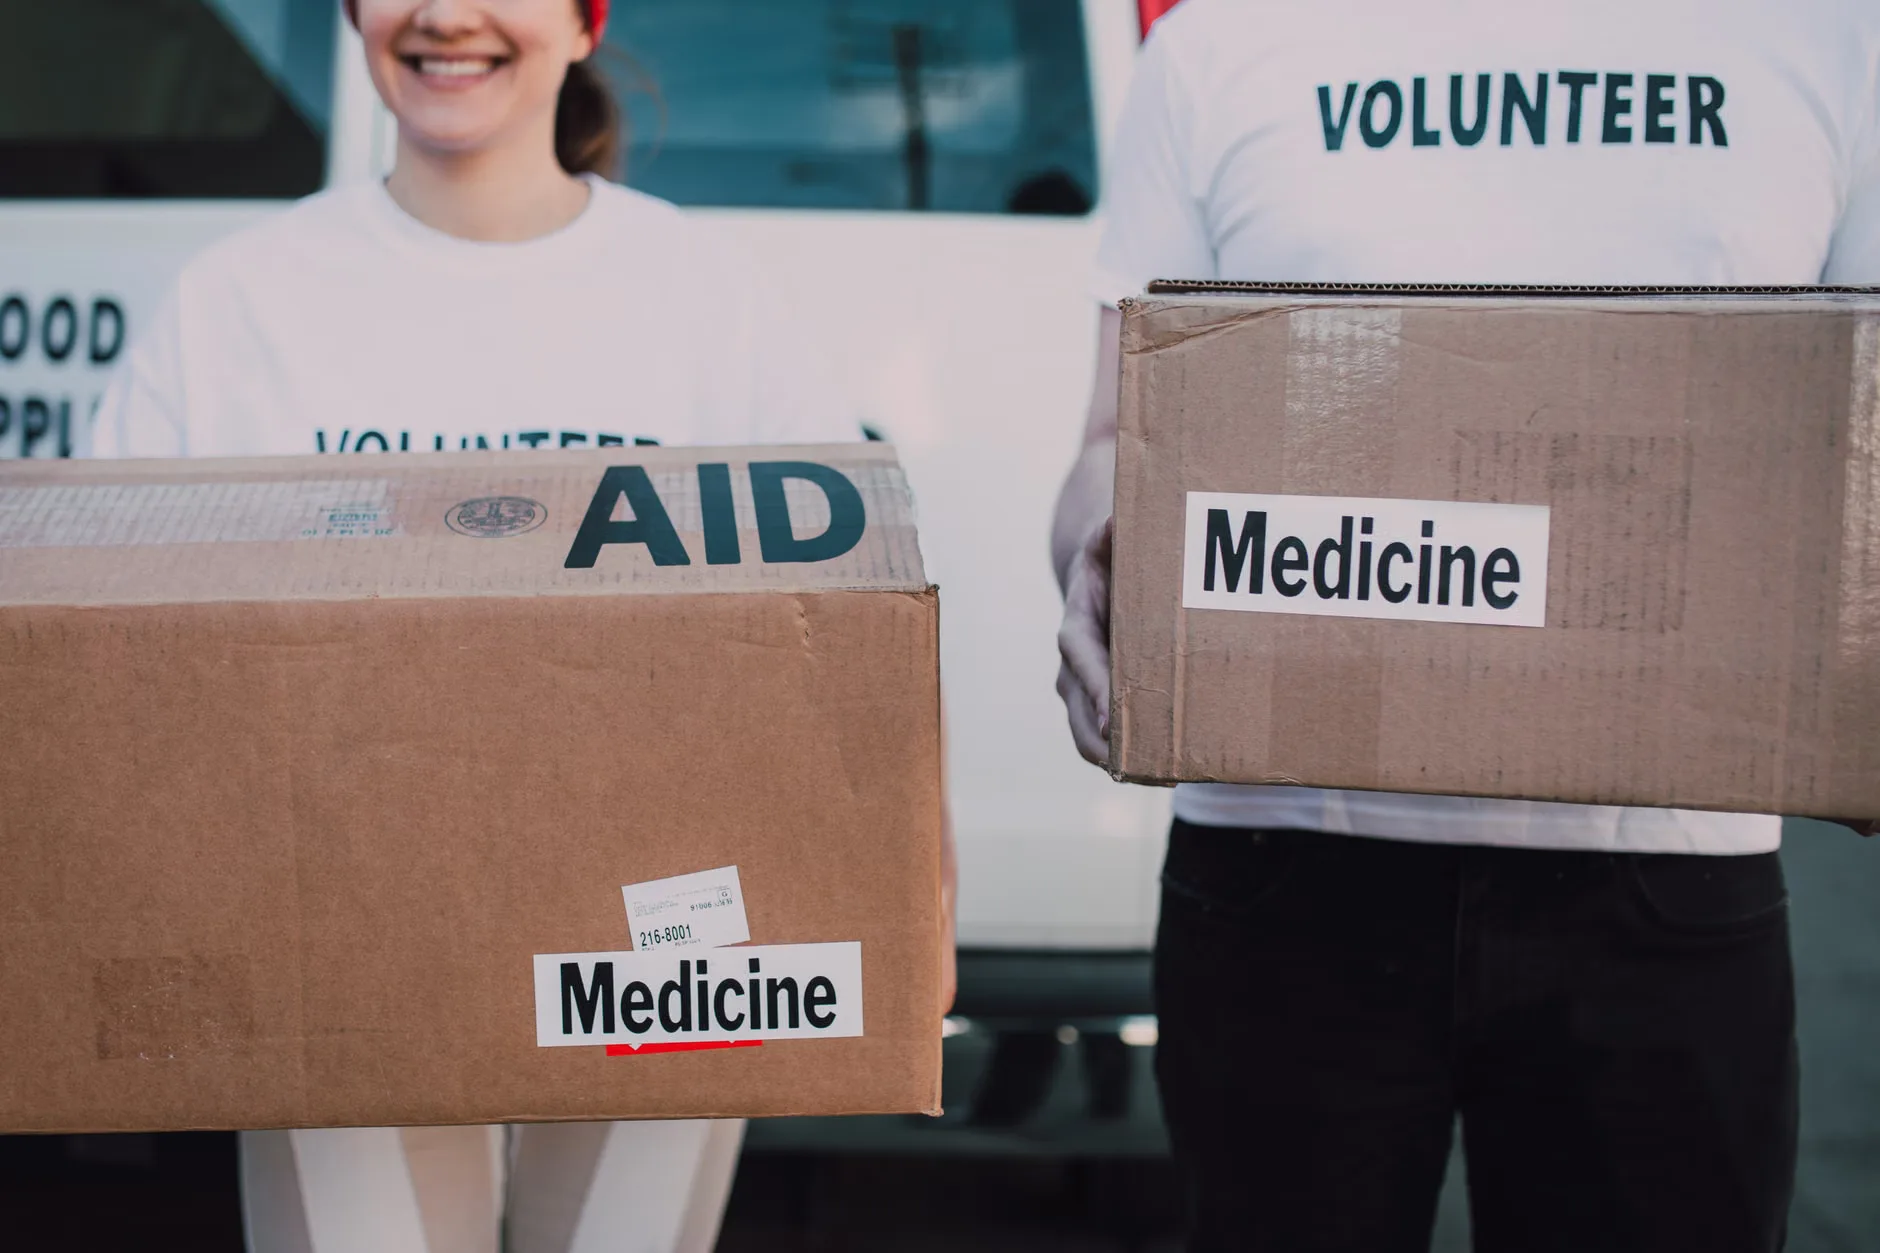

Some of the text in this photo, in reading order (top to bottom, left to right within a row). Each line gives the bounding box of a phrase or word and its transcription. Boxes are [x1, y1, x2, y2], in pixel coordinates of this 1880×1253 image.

[1316, 70, 1729, 151] VOLUNTEER
[563, 460, 866, 569] AID
[1203, 508, 1521, 610] Medicine
[640, 924, 692, 947] 216-8001
[560, 957, 837, 1035] Medicine
